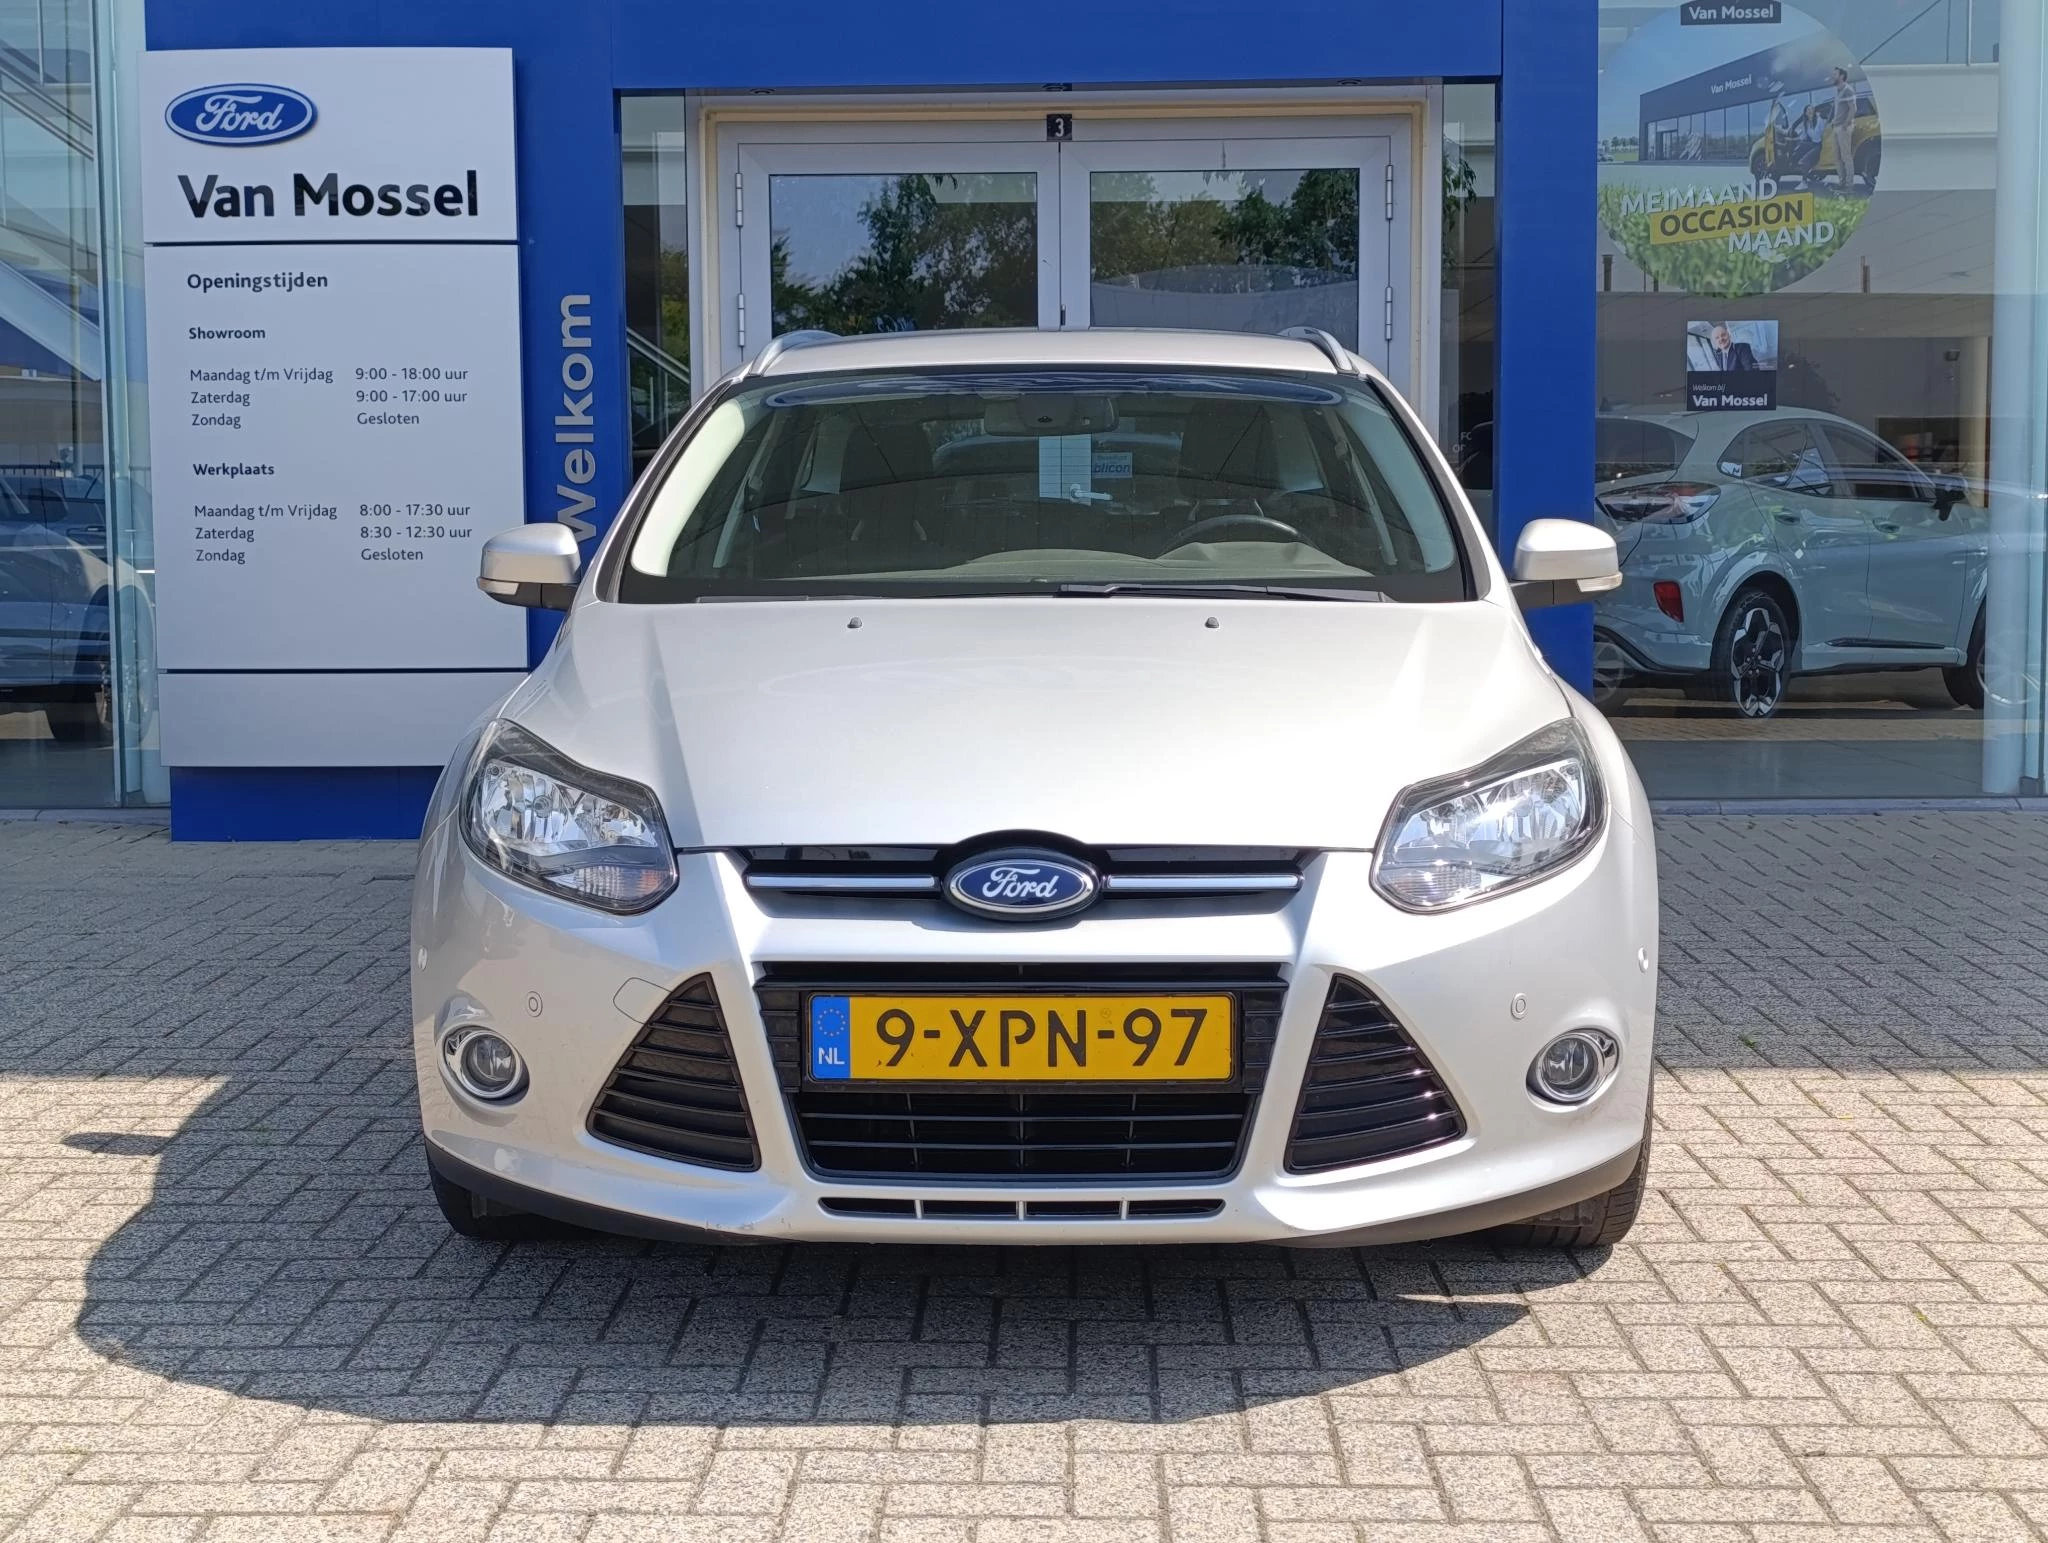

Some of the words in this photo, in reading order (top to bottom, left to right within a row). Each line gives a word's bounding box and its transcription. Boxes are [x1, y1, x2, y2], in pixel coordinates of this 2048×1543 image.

[1688, 6, 1717, 20] Van
[1721, 4, 1774, 19] Mossel
[1711, 84, 1724, 94] Van
[1725, 73, 1752, 91] Mossel
[195, 94, 285, 132] Ford
[1055, 118, 1065, 138] 3
[178, 174, 274, 218] Van
[293, 170, 478, 217] Mossel
[1621, 178, 1778, 216] MEIMAAND
[1660, 199, 1804, 237] OCCASION
[1728, 221, 1836, 254] MAAND
[187, 272, 328, 293] Openingstijden
[188, 327, 266, 340] Showroom
[190, 368, 250, 384] Maandag
[254, 368, 280, 381] t/m
[284, 368, 333, 384] Vrijdag
[355, 368, 387, 380] 9:00
[401, 368, 441, 380] 18:00
[445, 370, 469, 380] uur
[190, 391, 250, 406] Zaterdag
[356, 390, 388, 402] 9:00
[401, 390, 440, 402] 17:00
[444, 391, 468, 402] uur
[1692, 395, 1717, 406] Van
[1721, 394, 1768, 406] Mossel
[191, 413, 241, 429] Zondag
[356, 412, 420, 425] Gesloten
[555, 294, 597, 543] Welkom
[193, 463, 275, 479] Werkplaats
[194, 504, 255, 520] Maandag
[259, 504, 283, 517] t/m
[288, 504, 338, 520] Vrijdag
[359, 504, 392, 516] 8:00
[405, 504, 443, 516] 17:30
[447, 506, 471, 516] uur
[195, 527, 255, 542] Zaterdag
[360, 527, 392, 539] 8:30
[405, 526, 445, 538] 12:30
[449, 528, 473, 538] uur
[195, 549, 246, 565] Zondag
[360, 548, 424, 561] Gesloten
[982, 867, 1058, 898] Ford
[876, 1008, 1208, 1067] 9-XPN-97
[818, 1047, 845, 1065] NL
